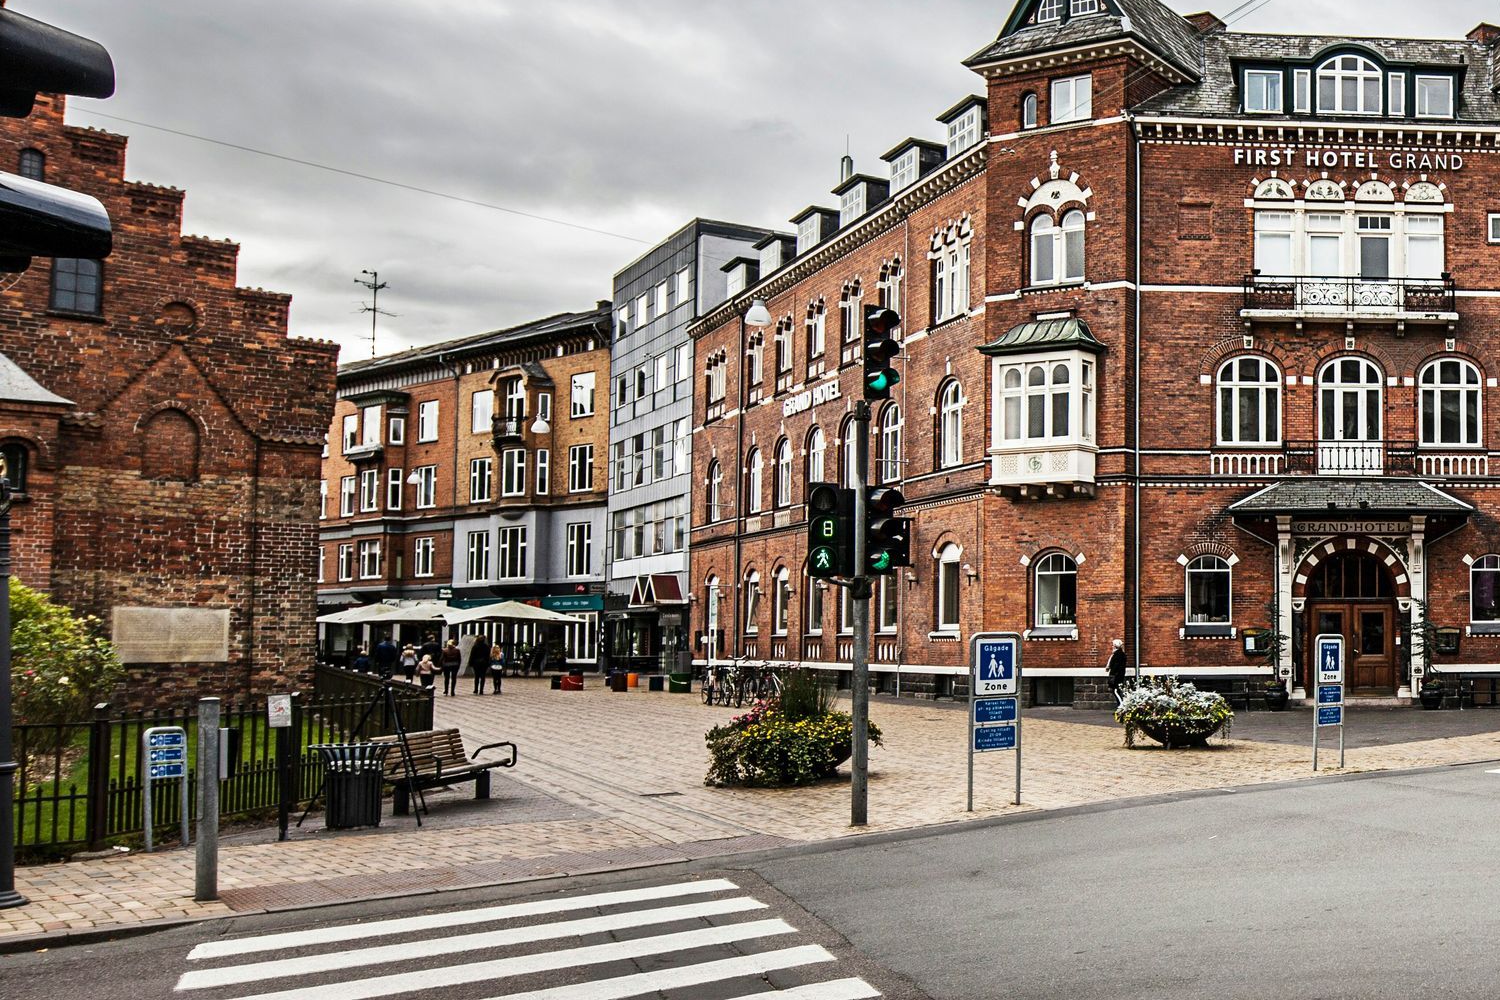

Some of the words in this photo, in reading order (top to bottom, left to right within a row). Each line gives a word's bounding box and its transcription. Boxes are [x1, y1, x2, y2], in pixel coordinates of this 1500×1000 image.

[1234, 148, 1296, 166] FIRST
[1306, 151, 1379, 168] HOTEL
[1389, 153, 1463, 170] GRAND
[783, 390, 812, 418] GRAND
[813, 379, 842, 408] HOTEL
[984, 644, 1009, 652] Gågade
[984, 682, 1008, 691] Zone
